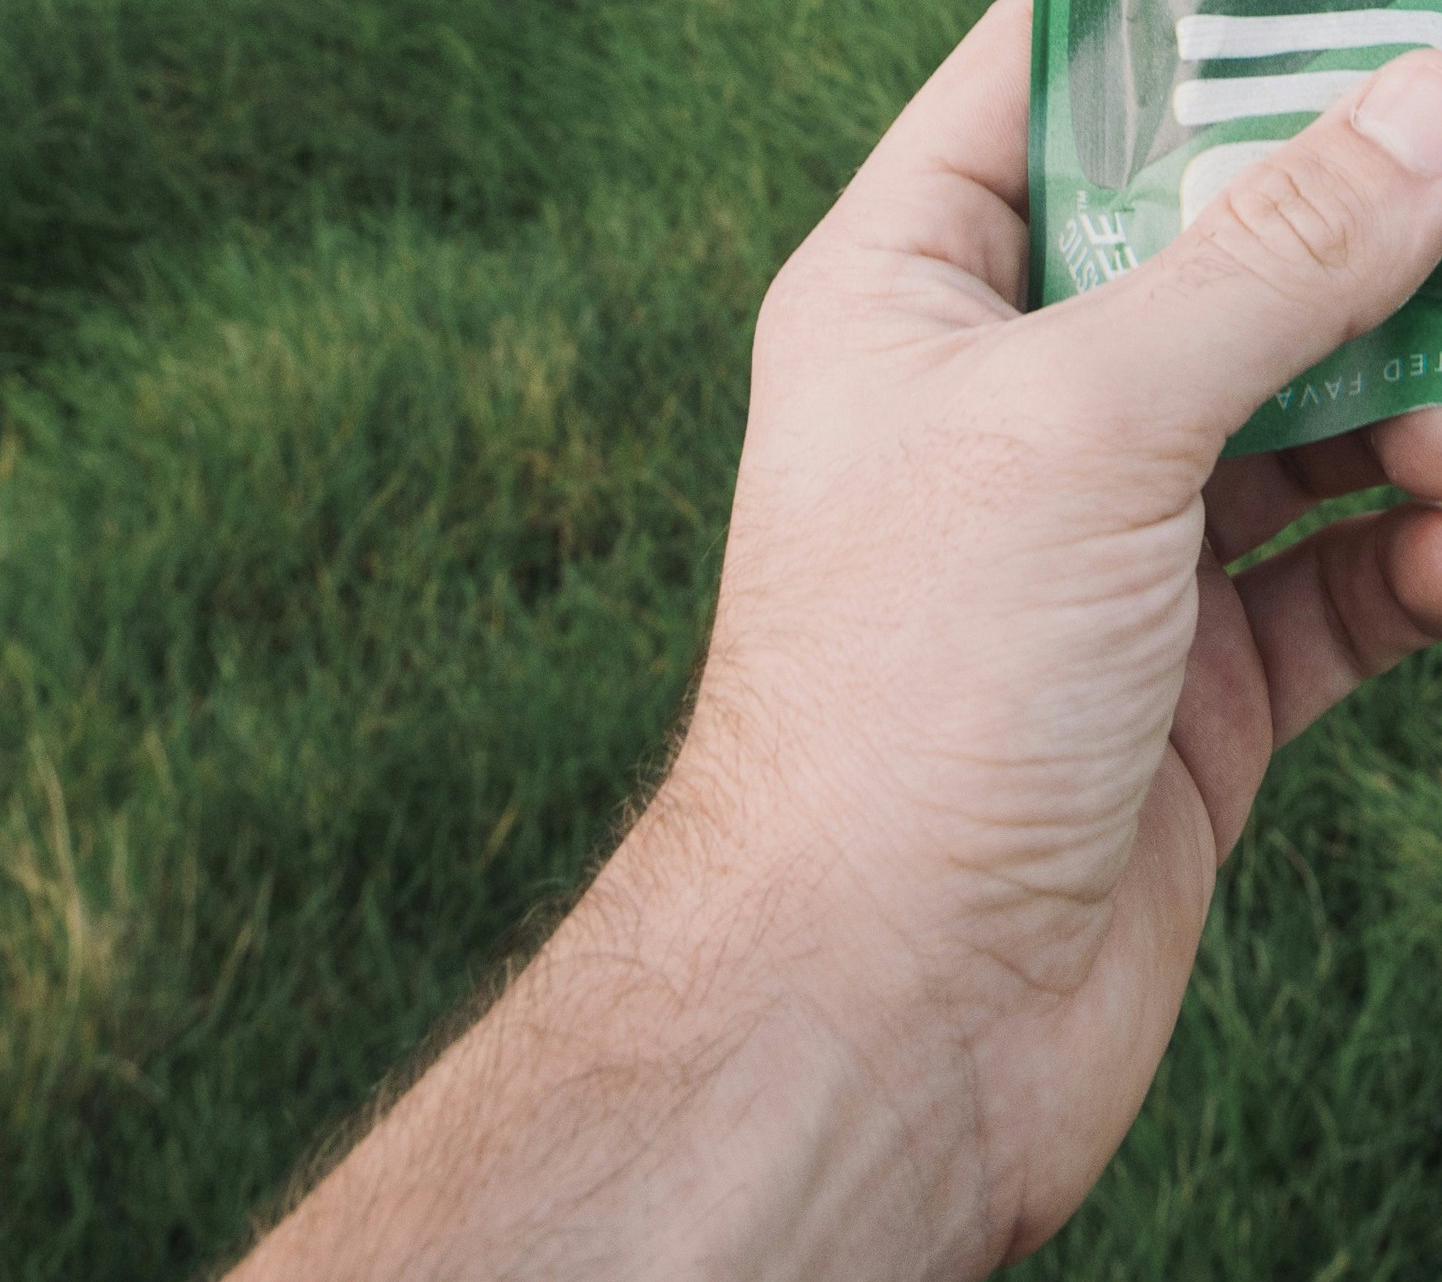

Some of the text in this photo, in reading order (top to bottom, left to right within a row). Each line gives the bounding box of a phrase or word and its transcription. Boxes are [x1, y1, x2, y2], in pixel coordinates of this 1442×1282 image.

[1059, 218, 1100, 294] STIC
[1079, 211, 1139, 282] EE
[1274, 371, 1363, 410] FAVA
